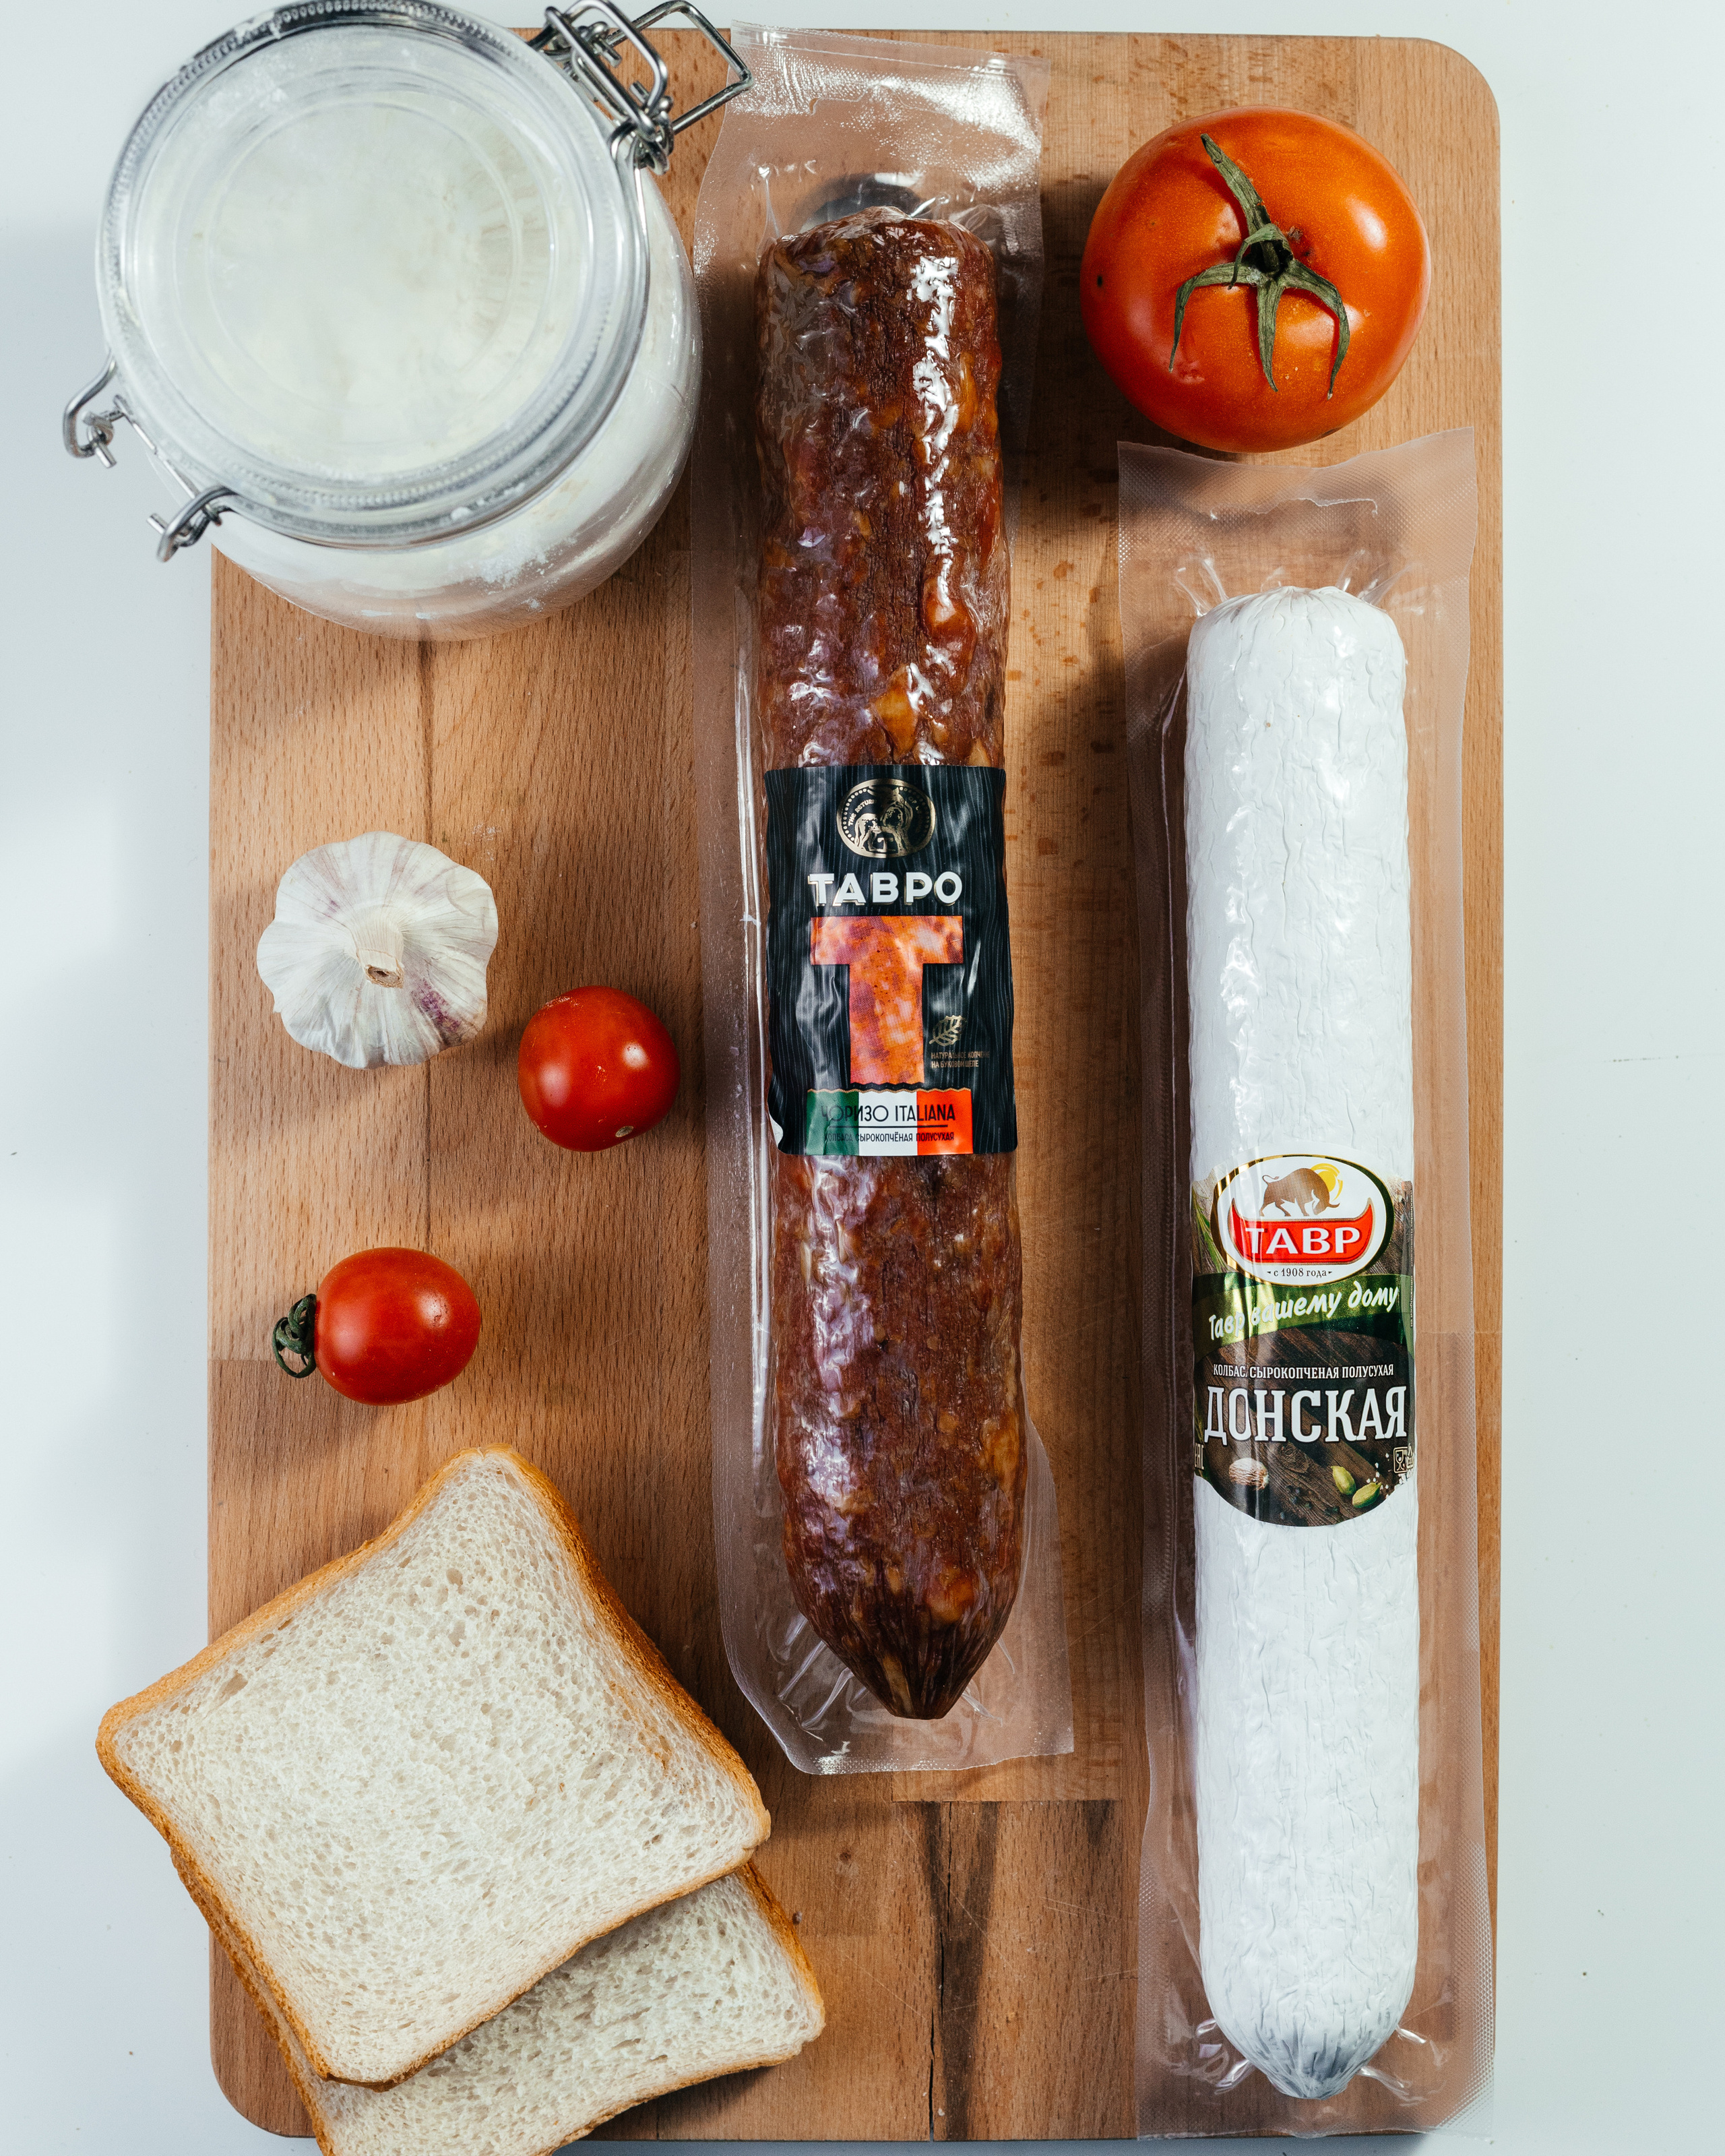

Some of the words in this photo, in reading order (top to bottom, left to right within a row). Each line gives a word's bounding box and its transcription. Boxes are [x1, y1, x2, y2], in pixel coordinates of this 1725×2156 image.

[848, 813, 856, 826] THE
[808, 871, 962, 906] ТАВРО
[940, 1059, 965, 1068] БУКОВОЙ
[821, 1105, 889, 1122] ЧОРИЗО
[895, 1104, 955, 1122] ITALIANA
[825, 1133, 853, 1142] ОЛБАСА
[856, 1132, 913, 1142] СЫРОКОПЧЁНАЯ
[916, 1132, 954, 1142] ПОЛУСУХАЯ
[1245, 1227, 1360, 1255] ТАВР
[1281, 1268, 1304, 1277] 1908
[1306, 1269, 1327, 1279] года
[1208, 1311, 1245, 1341] Тавр
[1251, 1291, 1342, 1326] вашему
[1348, 1280, 1399, 1313] дому
[1214, 1363, 1248, 1378] КОЛБАС
[1249, 1366, 1340, 1379] СЫРОКОПЧЕНАЯ
[1342, 1363, 1393, 1378] ПОЛУСУХАЯ
[1203, 1386, 1407, 1446] ДОНСКАЯ
